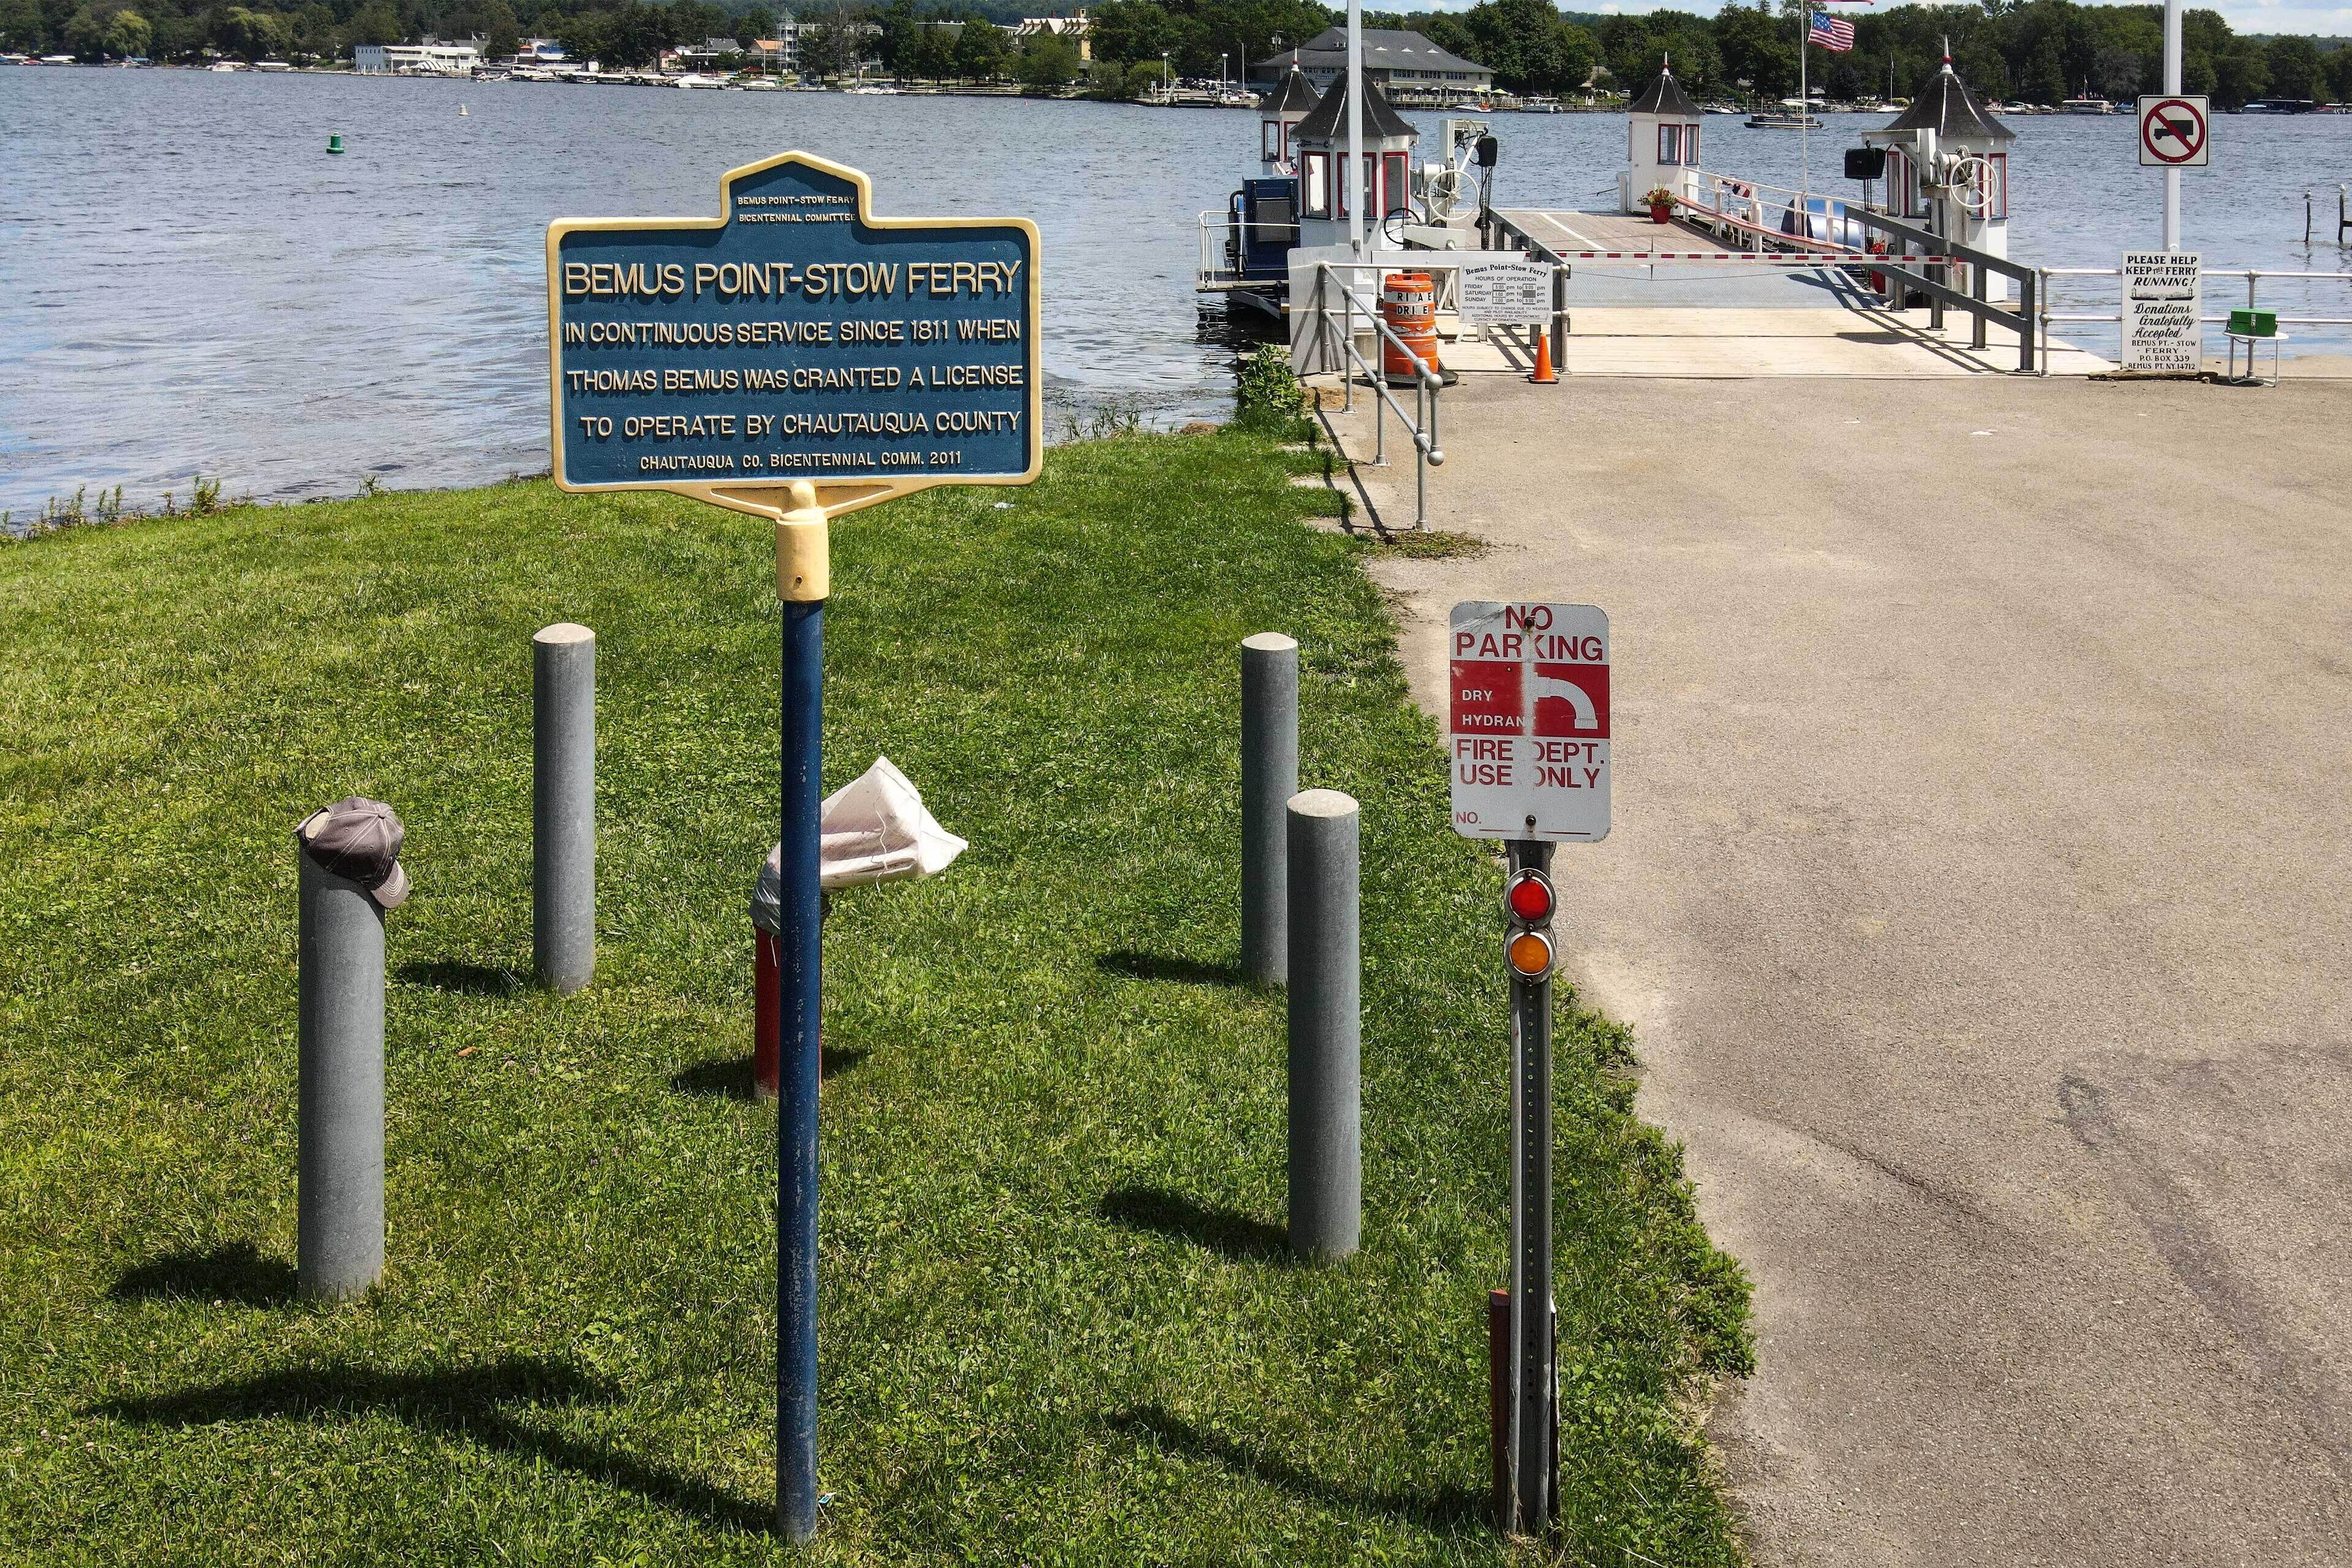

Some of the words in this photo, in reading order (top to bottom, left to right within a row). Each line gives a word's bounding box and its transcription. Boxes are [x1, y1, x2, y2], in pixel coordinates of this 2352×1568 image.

[769, 196, 824, 205] POINT-STOW
[2127, 255, 2166, 264] PLEASE
[2171, 256, 2197, 265] HELP
[565, 263, 685, 295] BEMUS
[695, 262, 898, 295] POINT-STOW
[907, 260, 1022, 294] FERRY
[1465, 266, 1487, 275] Bemus
[1529, 267, 1547, 277] Ferry
[2133, 277, 2196, 287] RUNNING!
[2134, 303, 2193, 314] Donations
[2139, 315, 2196, 330] Gratefully
[565, 323, 585, 343] IN
[590, 322, 733, 343] CONTINUOUS
[737, 322, 832, 342] SERVICE
[840, 320, 904, 341] SINCE
[910, 320, 949, 340] 1811
[957, 320, 1020, 339] WHEN
[2132, 327, 2182, 340] Accepted
[567, 370, 657, 390] THOMAS
[665, 369, 739, 389] BEMUS
[743, 369, 788, 388] WAS
[794, 368, 900, 388] GRANTED
[908, 367, 925, 386] A
[931, 365, 1023, 386] LICENSE
[581, 417, 612, 437] TO
[624, 415, 735, 437] OPERATE
[746, 415, 775, 435] BY
[783, 413, 929, 434] CHAUTAUQUA
[935, 411, 1020, 431] COUNTY
[640, 455, 733, 470] CHAUTAUQUA
[742, 454, 763, 468] CO.
[771, 452, 875, 467] BICENTENNIAL
[881, 451, 924, 466] COMM.
[930, 450, 961, 464] 2011
[1506, 605, 1553, 630] NO
[1457, 632, 1603, 661] PARKING
[1462, 690, 1494, 702] DRY
[1462, 714, 1525, 728] HYDRAN
[1457, 739, 1513, 761] FIRE
[1461, 764, 1512, 785] USE
[1532, 766, 1599, 788] ONLY
[1456, 812, 1481, 824] NO.
